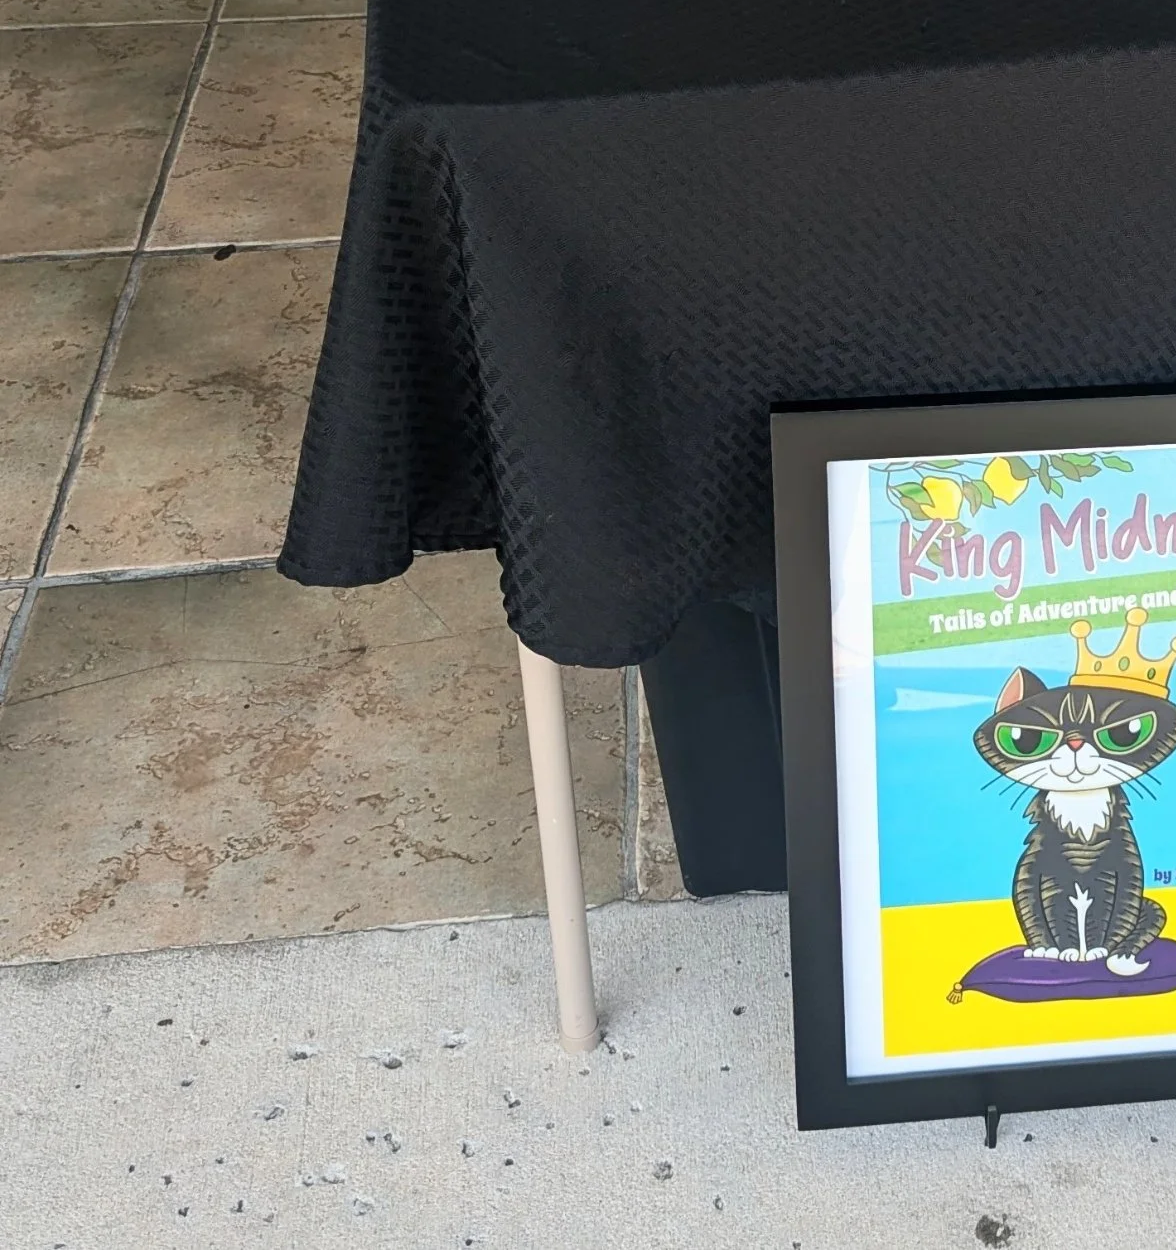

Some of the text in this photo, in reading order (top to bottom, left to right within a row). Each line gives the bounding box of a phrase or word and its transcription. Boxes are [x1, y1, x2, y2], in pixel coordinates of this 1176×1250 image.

[898, 517, 1023, 600] King
[929, 607, 988, 634] Tails
[989, 602, 1015, 626] of
[1018, 593, 1138, 622] Adventure
[1153, 868, 1172, 885] by
